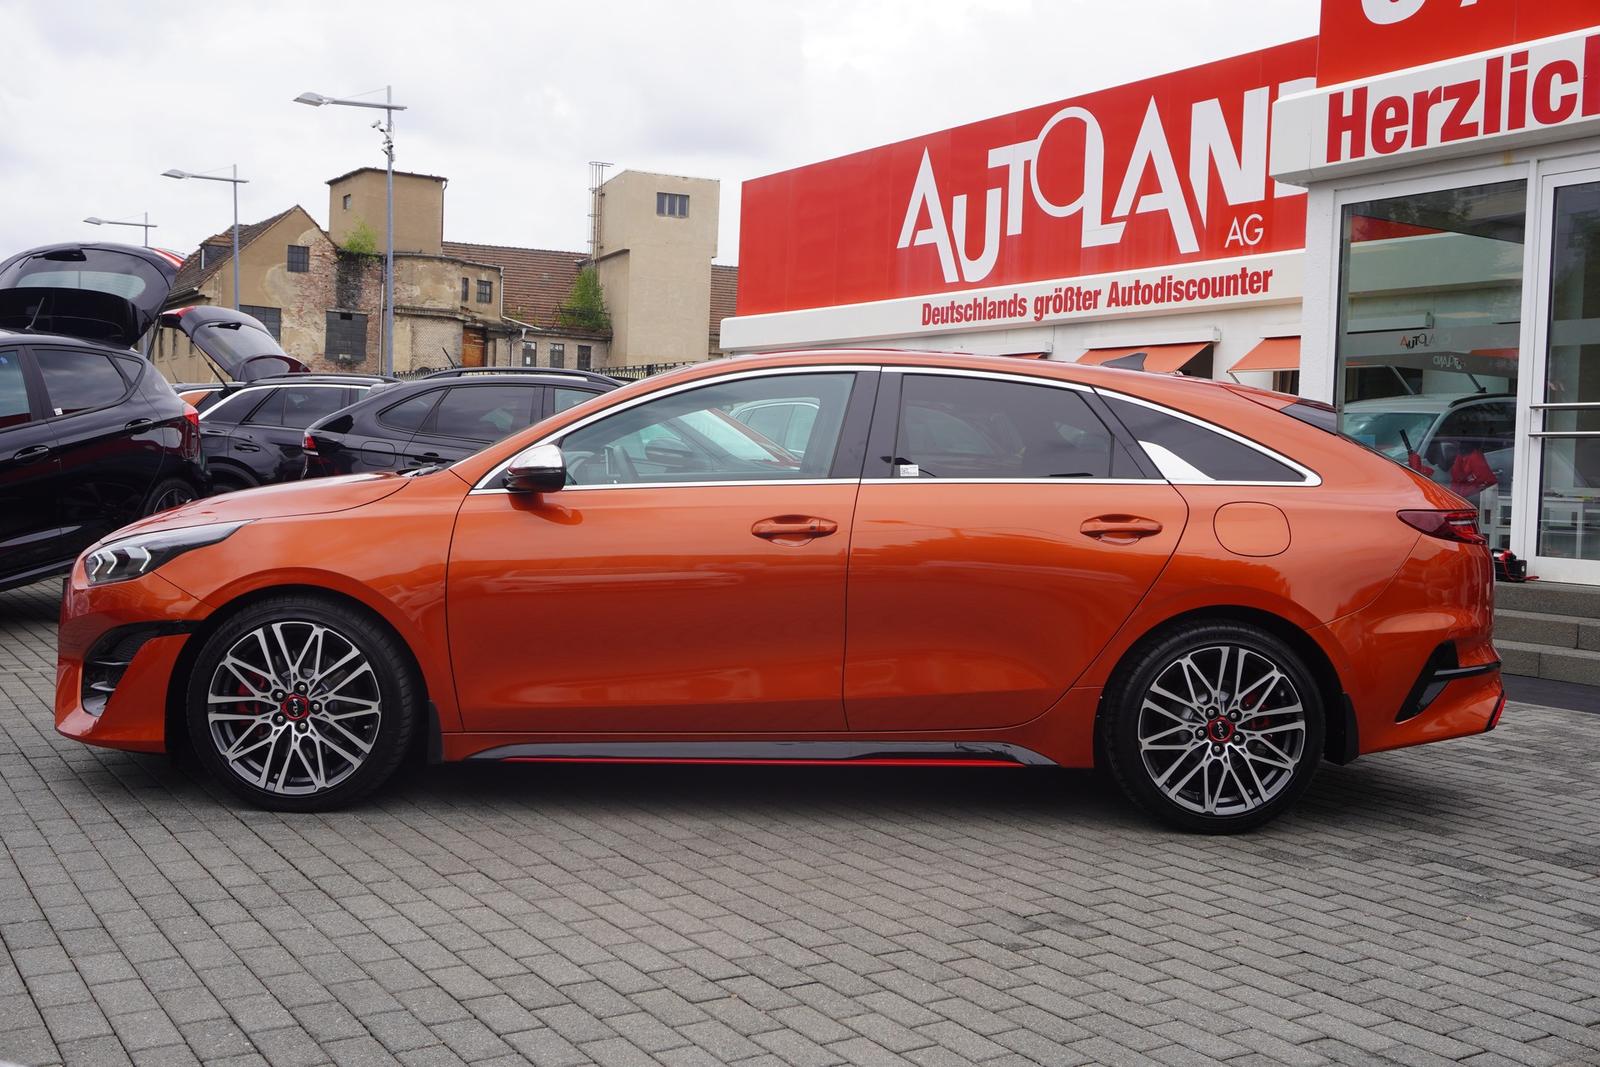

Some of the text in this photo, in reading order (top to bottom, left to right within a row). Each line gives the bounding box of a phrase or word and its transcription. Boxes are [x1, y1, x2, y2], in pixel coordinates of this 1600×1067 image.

[1224, 213, 1264, 248] AG
[921, 267, 1273, 325] Deutschlands größter Autodiscounter
